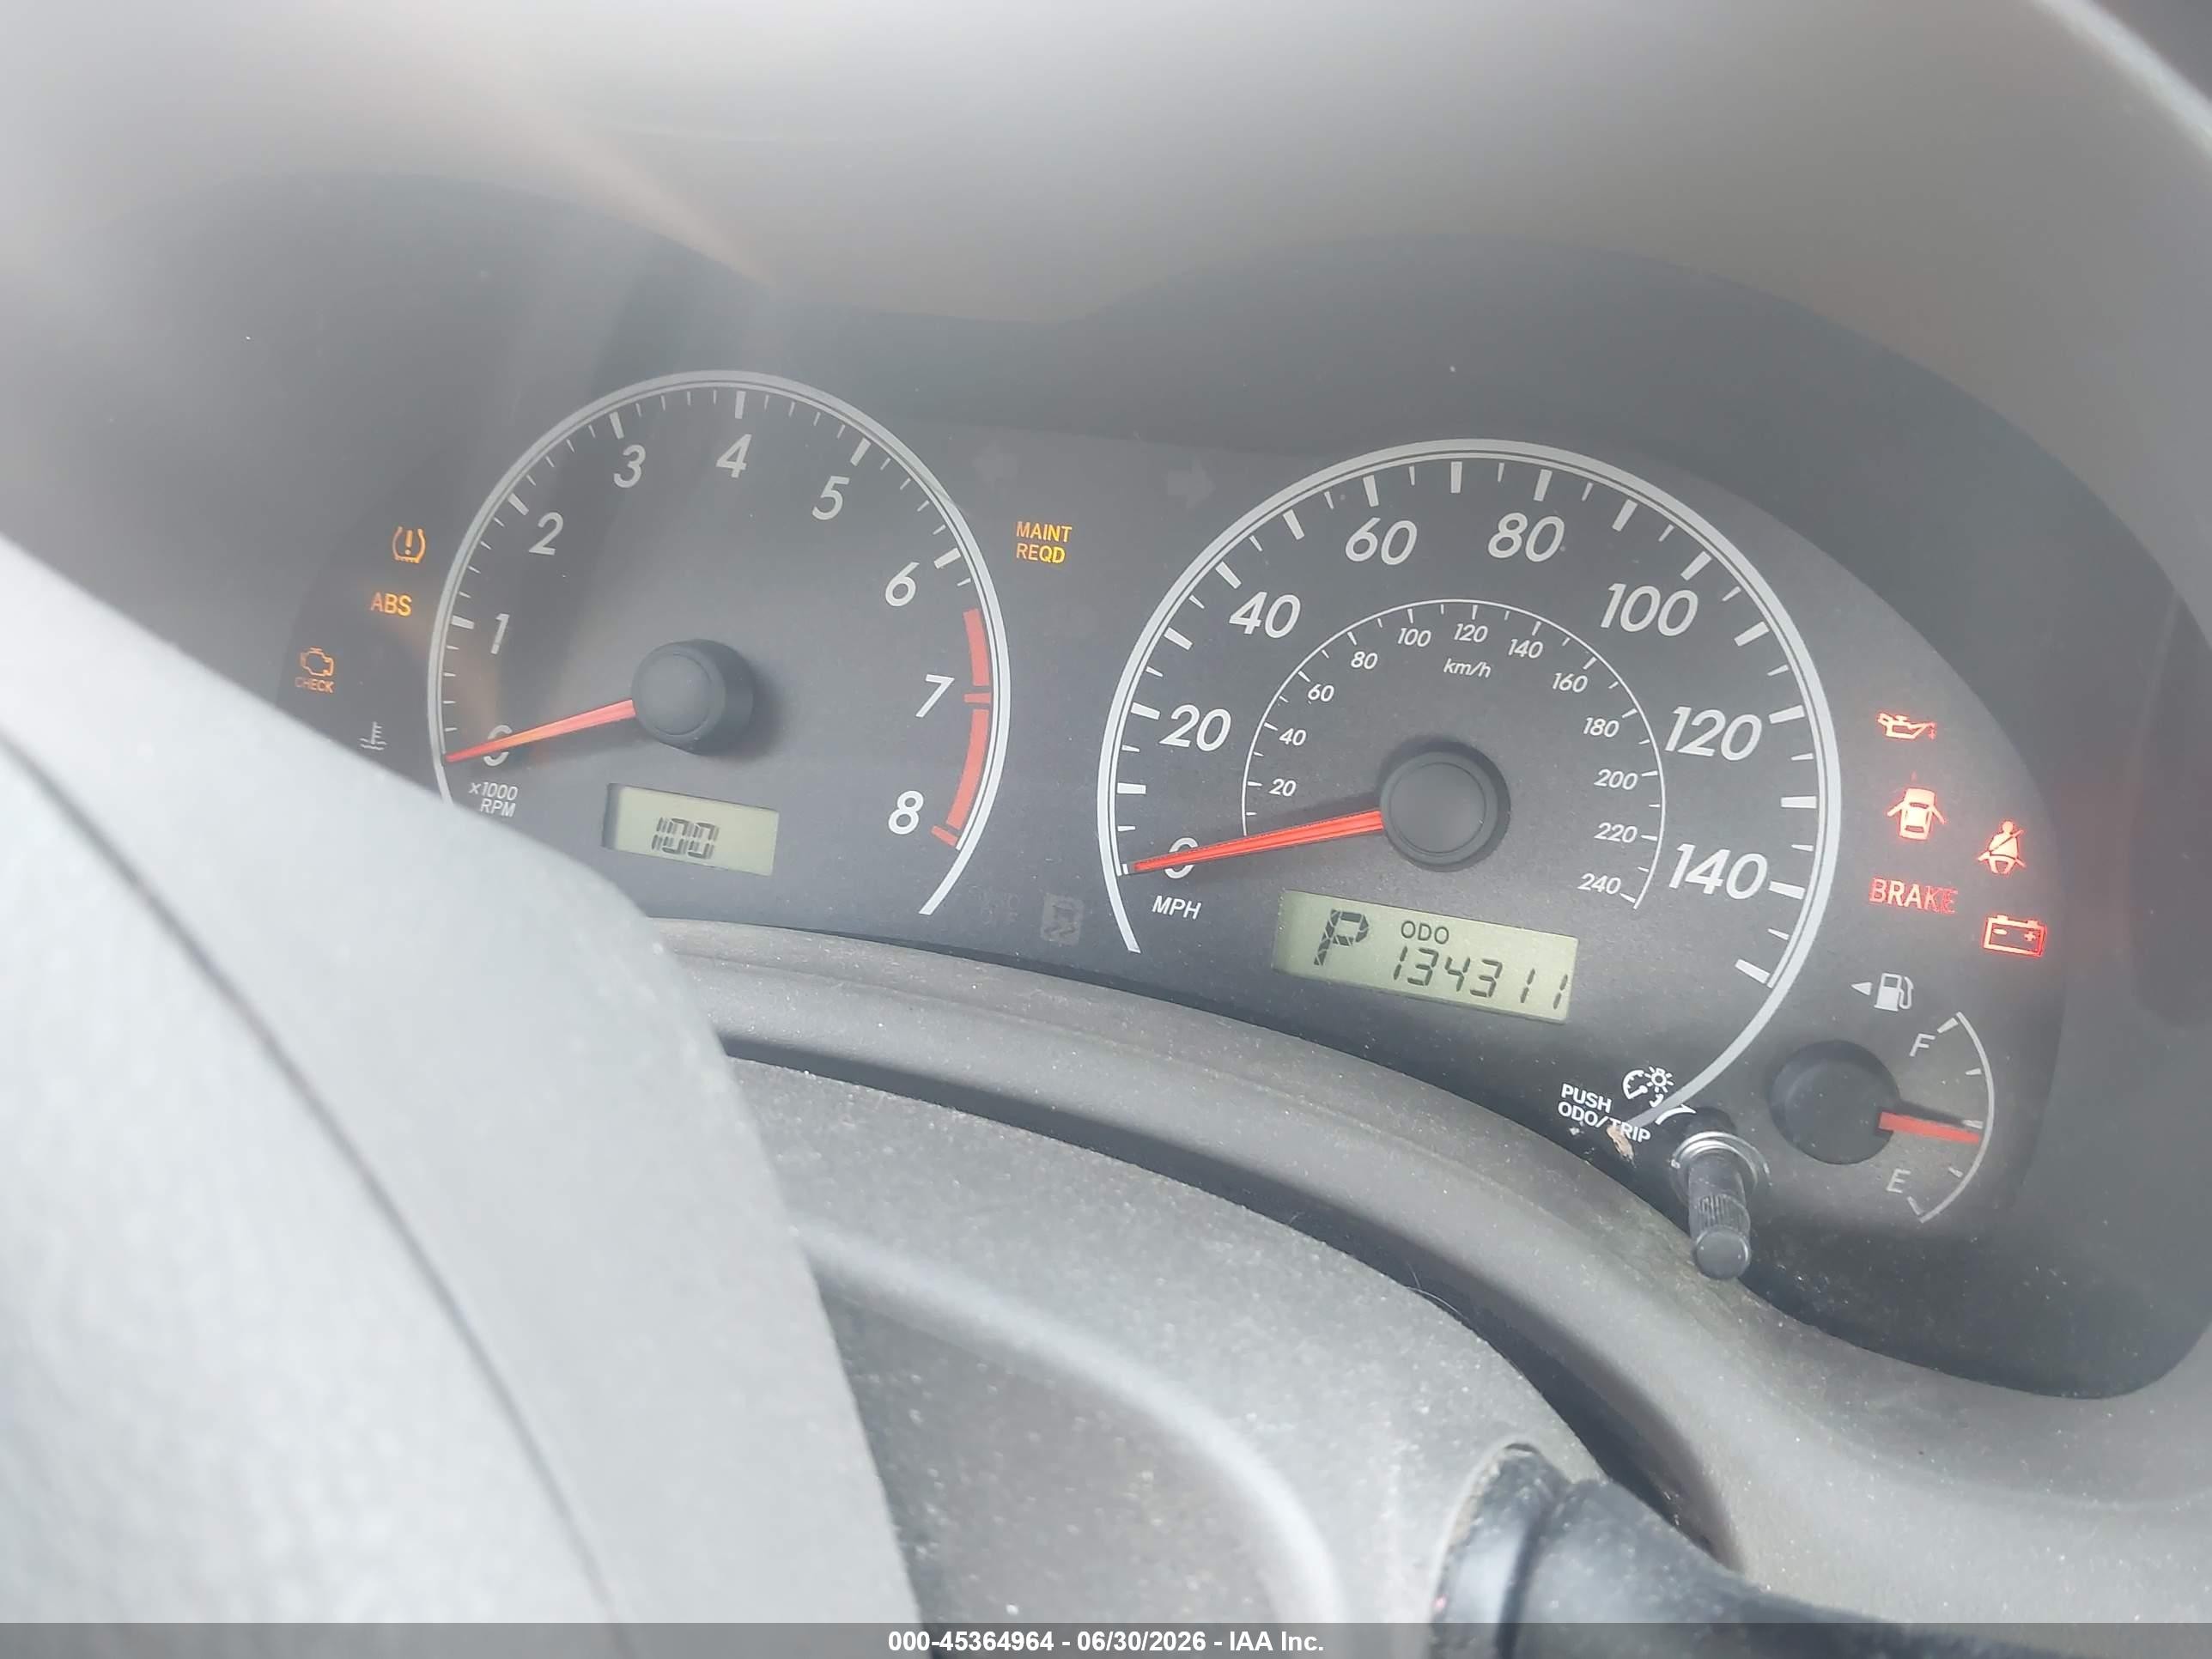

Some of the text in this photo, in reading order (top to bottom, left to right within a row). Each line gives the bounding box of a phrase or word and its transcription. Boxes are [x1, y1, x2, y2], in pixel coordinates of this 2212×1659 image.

[613, 445, 646, 488] 3
[715, 434, 751, 477] 4
[811, 476, 850, 520] 5
[528, 513, 563, 555] 2
[1016, 520, 1072, 543] MAINT
[1345, 517, 1418, 565] 60
[1487, 513, 1565, 562] 80
[1016, 543, 1066, 564] REQD
[884, 562, 920, 606] 6
[371, 592, 412, 616] ABS
[1229, 592, 1301, 638] 40
[1600, 583, 1698, 636] 100
[490, 613, 510, 654] 1
[1397, 628, 1431, 647] 100
[1454, 623, 1488, 643] 120
[1351, 651, 1378, 670] 80
[1508, 639, 1544, 659] 140
[1443, 659, 1492, 678] km/h
[295, 677, 335, 694] CHECK
[1308, 684, 1334, 702] 60
[1552, 672, 1588, 693] 160
[915, 674, 955, 718] 7
[1159, 704, 1231, 751] 20
[1279, 728, 1307, 746] 40
[1583, 717, 1620, 738] 180
[1665, 706, 1762, 761] 120
[1268, 778, 1297, 797] 20
[1594, 769, 1638, 790] 200
[480, 798, 516, 817] RPM
[888, 790, 924, 835] 8
[1594, 822, 1638, 843] 220
[1577, 872, 1621, 895] 240
[1669, 843, 1768, 900] 140
[1152, 895, 1202, 920] MPH
[1869, 878, 1958, 914] BRAKE
[1314, 908, 1370, 966] P
[1401, 921, 1449, 945] ODO
[1394, 945, 1569, 1010] 134311
[1909, 1032, 1936, 1057] F
[1561, 1083, 1612, 1114] PUSH
[1558, 1101, 1651, 1143] ODO/TRIP
[1886, 1168, 1911, 1194] E
